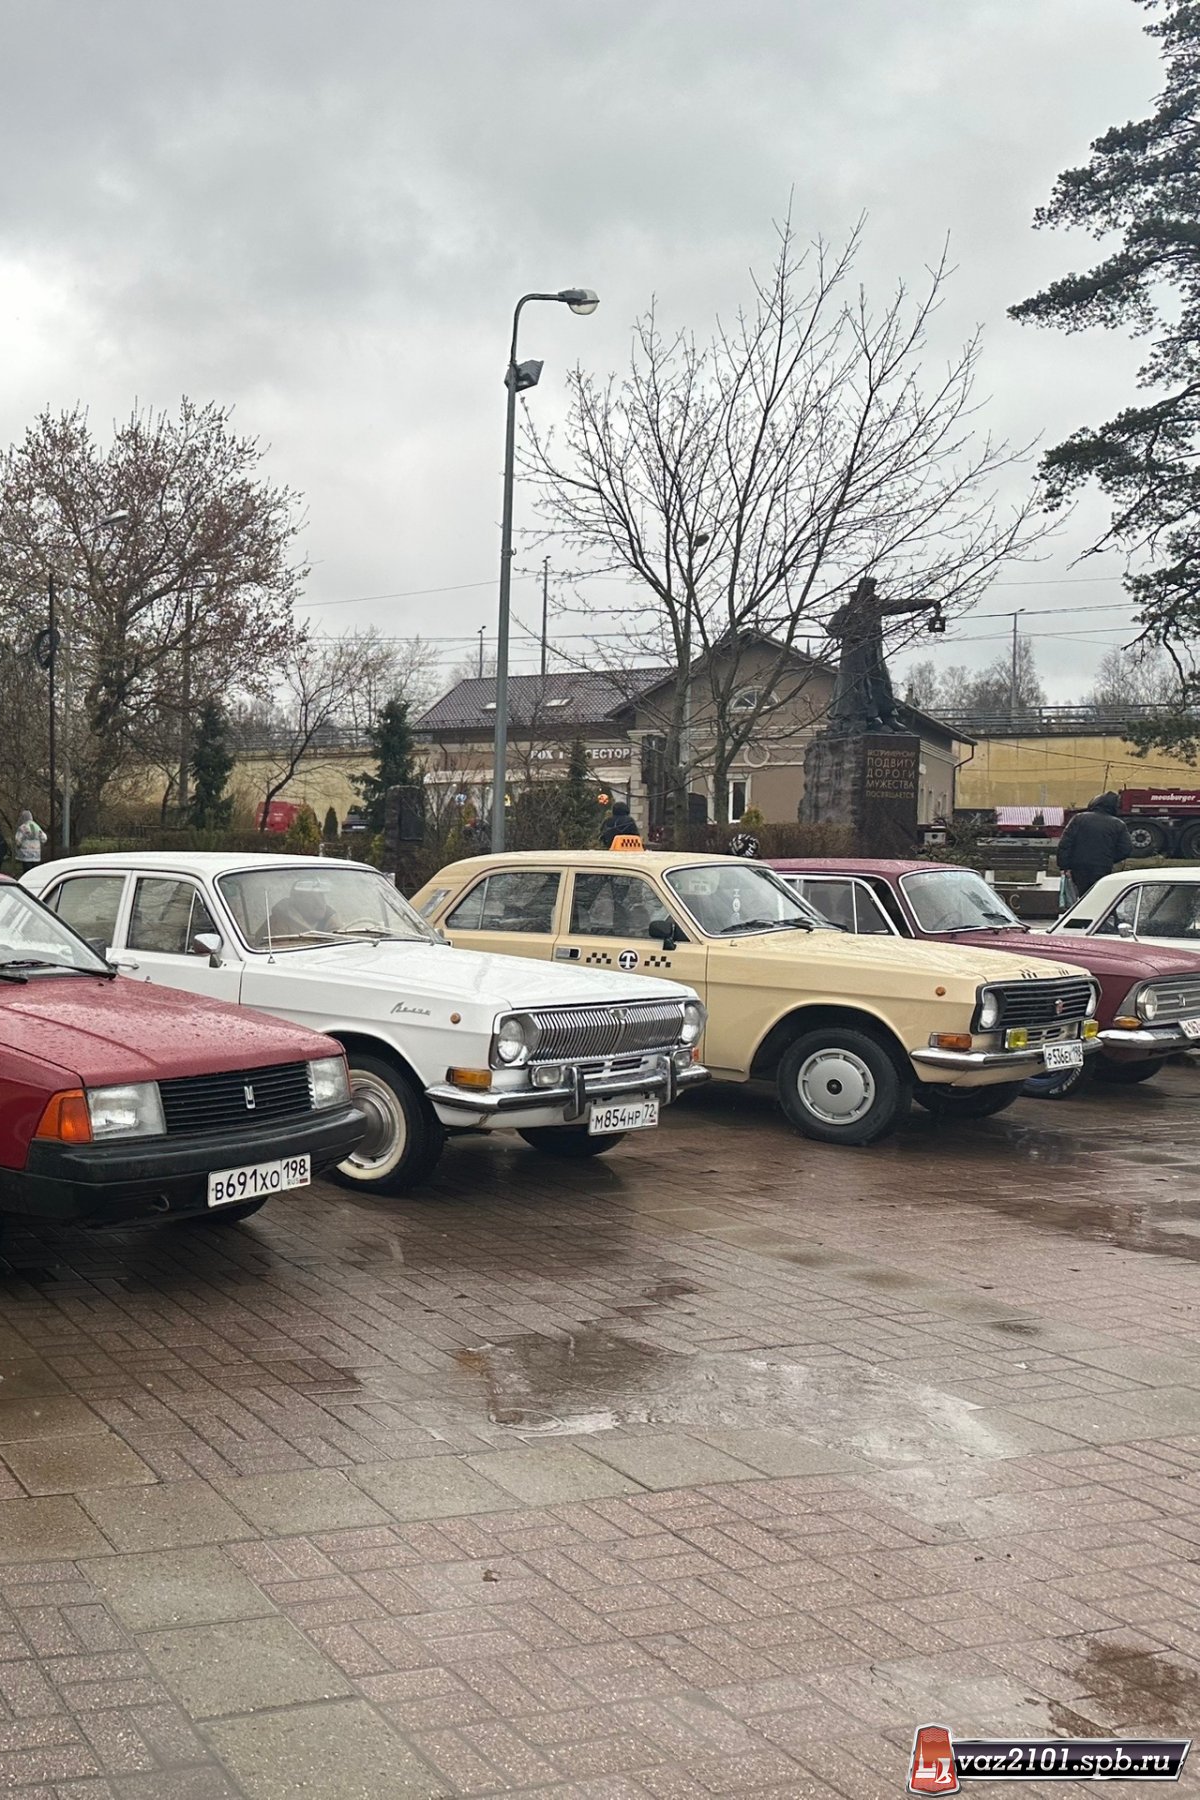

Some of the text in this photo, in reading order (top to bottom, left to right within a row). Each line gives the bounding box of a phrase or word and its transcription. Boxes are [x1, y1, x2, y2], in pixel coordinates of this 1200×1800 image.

[867, 757, 916, 769] ПОДВИГУ
[866, 768, 915, 779] ДОРОГИ
[865, 779, 915, 790] МУЖЕСТВА
[595, 1103, 656, 1130] М854НР 72
[214, 1158, 307, 1201] В691ХО 198
